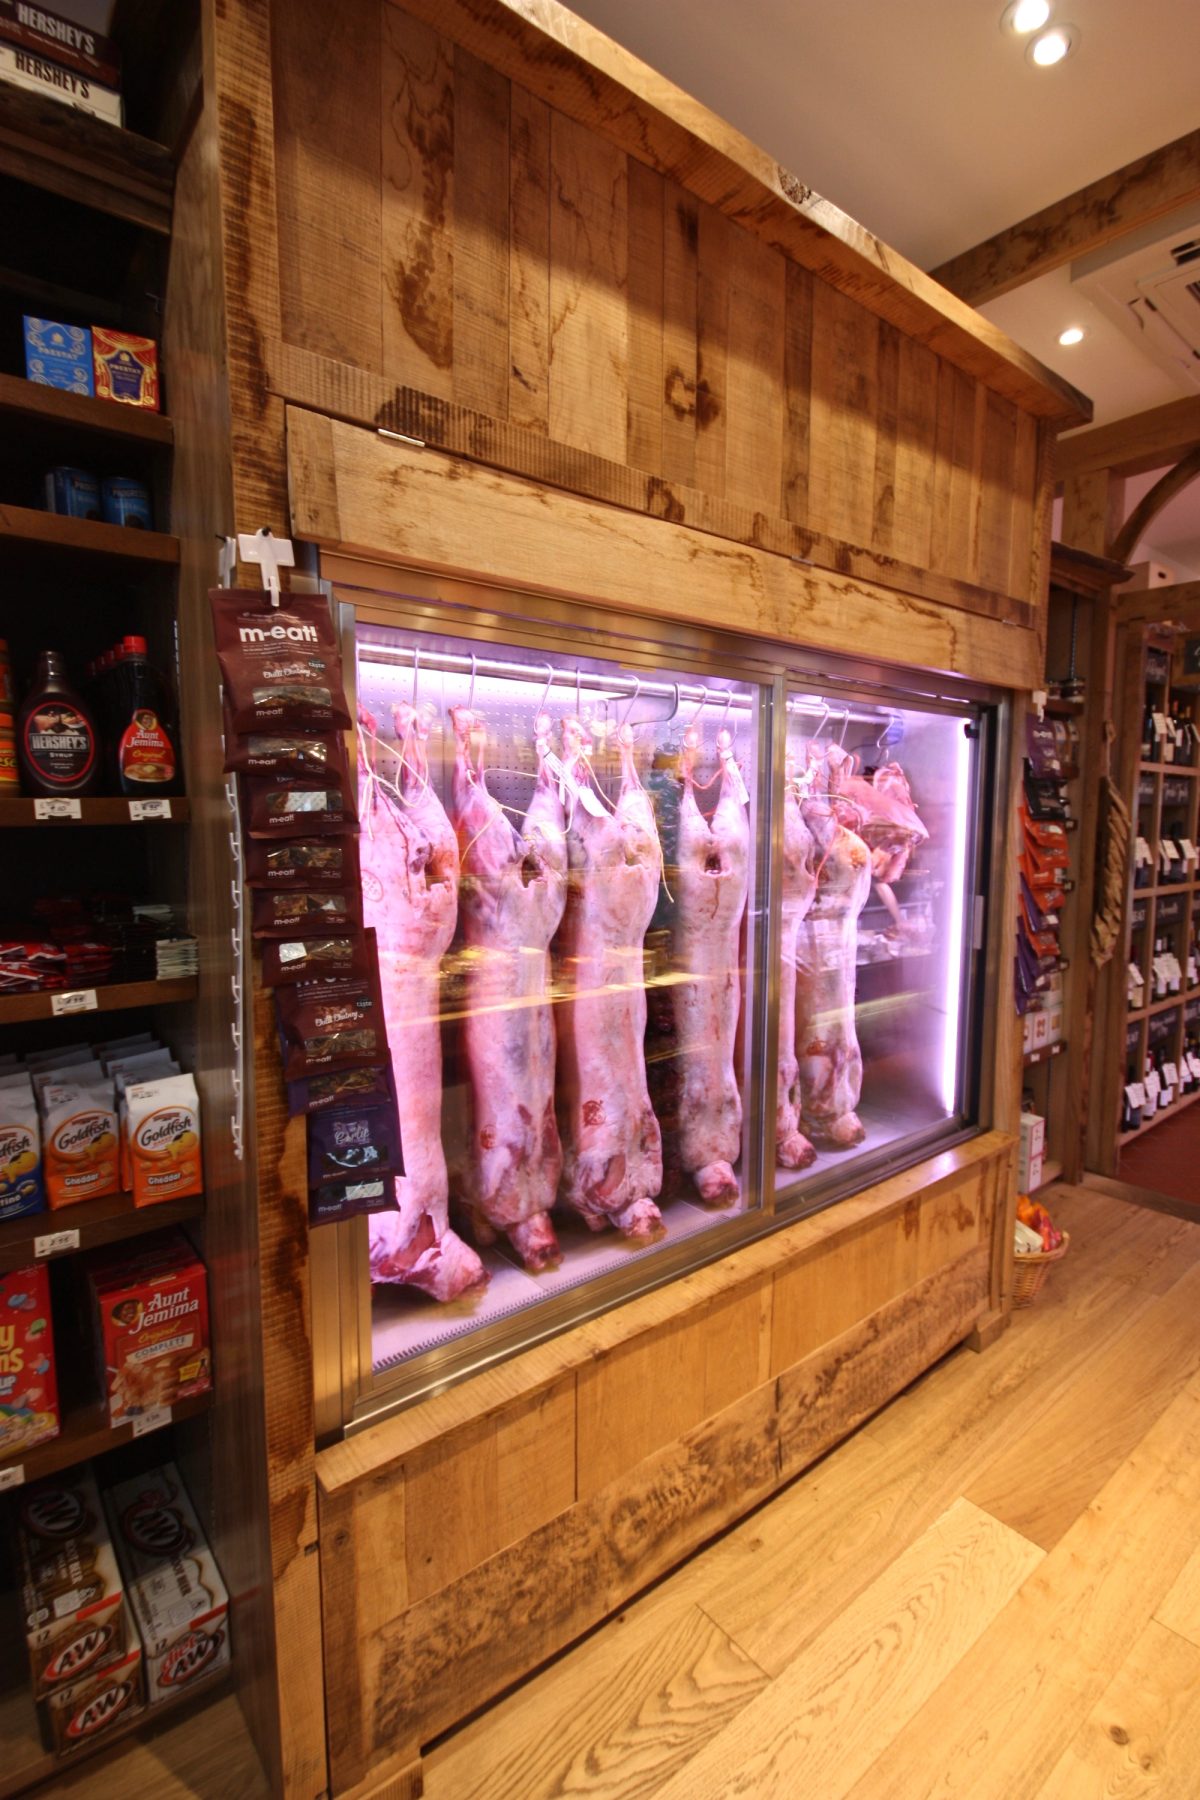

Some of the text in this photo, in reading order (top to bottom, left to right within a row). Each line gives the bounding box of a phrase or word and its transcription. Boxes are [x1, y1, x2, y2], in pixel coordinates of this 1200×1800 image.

[18, 2, 96, 56] HERSHEY'S
[15, 50, 90, 99] HERSHEYS
[239, 625, 318, 642] m-eat!
[32, 735, 87, 749] HERSHEY'S
[58, 1118, 111, 1150] Goldfish
[141, 1116, 192, 1147] Goldfish
[64, 1173, 99, 1186] Cheddar
[148, 1172, 182, 1185] Cheddar
[148, 1287, 190, 1312] Aunt
[128, 1299, 199, 1335] Jemima
[135, 1336, 186, 1358] COMPLETE
